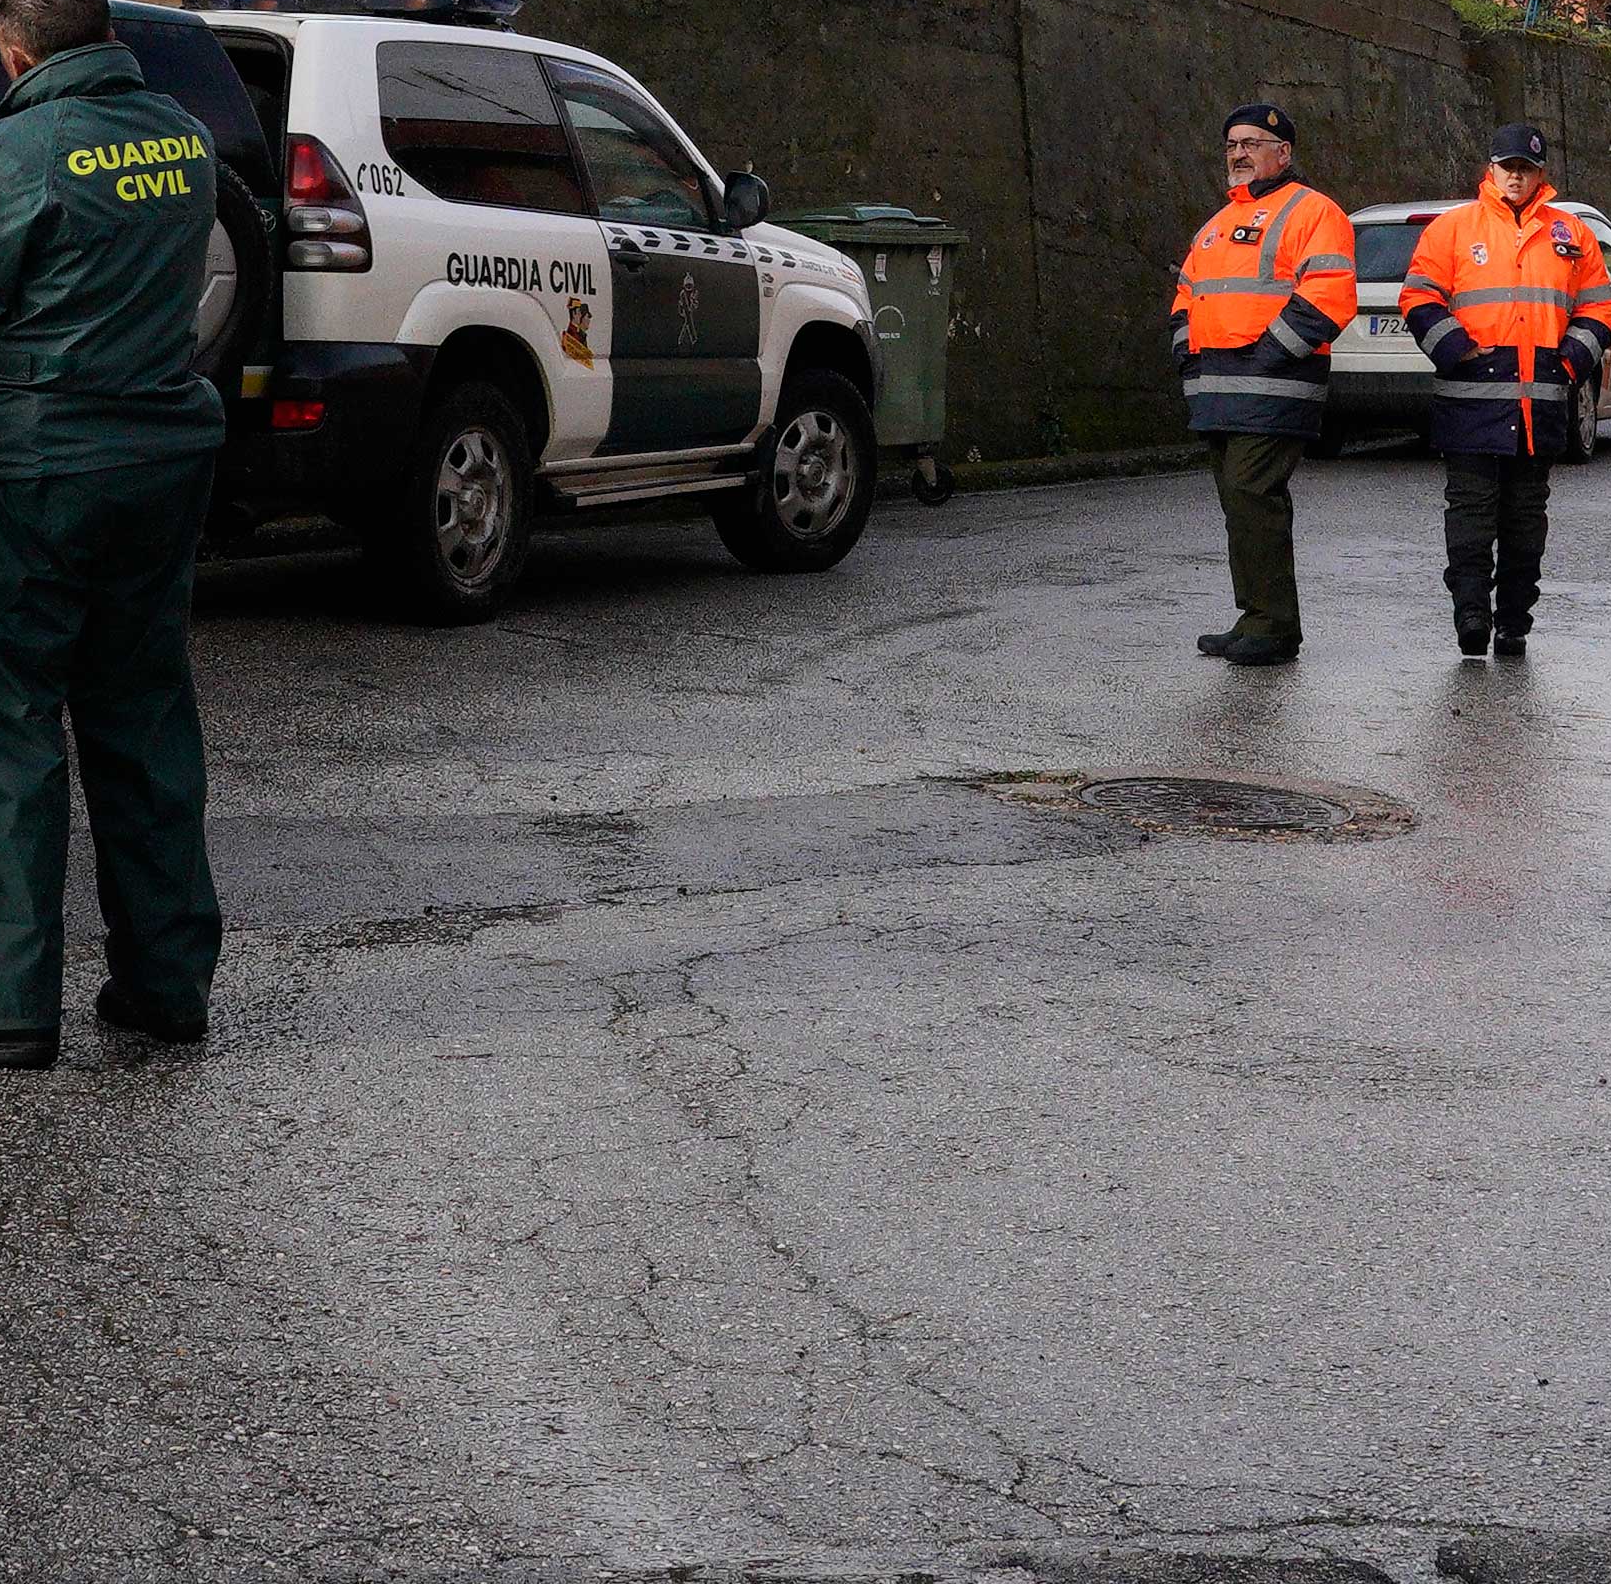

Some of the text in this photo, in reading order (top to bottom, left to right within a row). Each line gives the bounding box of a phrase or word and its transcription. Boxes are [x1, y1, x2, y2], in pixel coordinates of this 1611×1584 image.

[67, 135, 207, 176] GUARDIA
[116, 169, 191, 202] CIVIL
[370, 163, 405, 197] 062
[446, 252, 597, 295] GUARDIA CIVIL
[1380, 318, 1409, 334] 724
